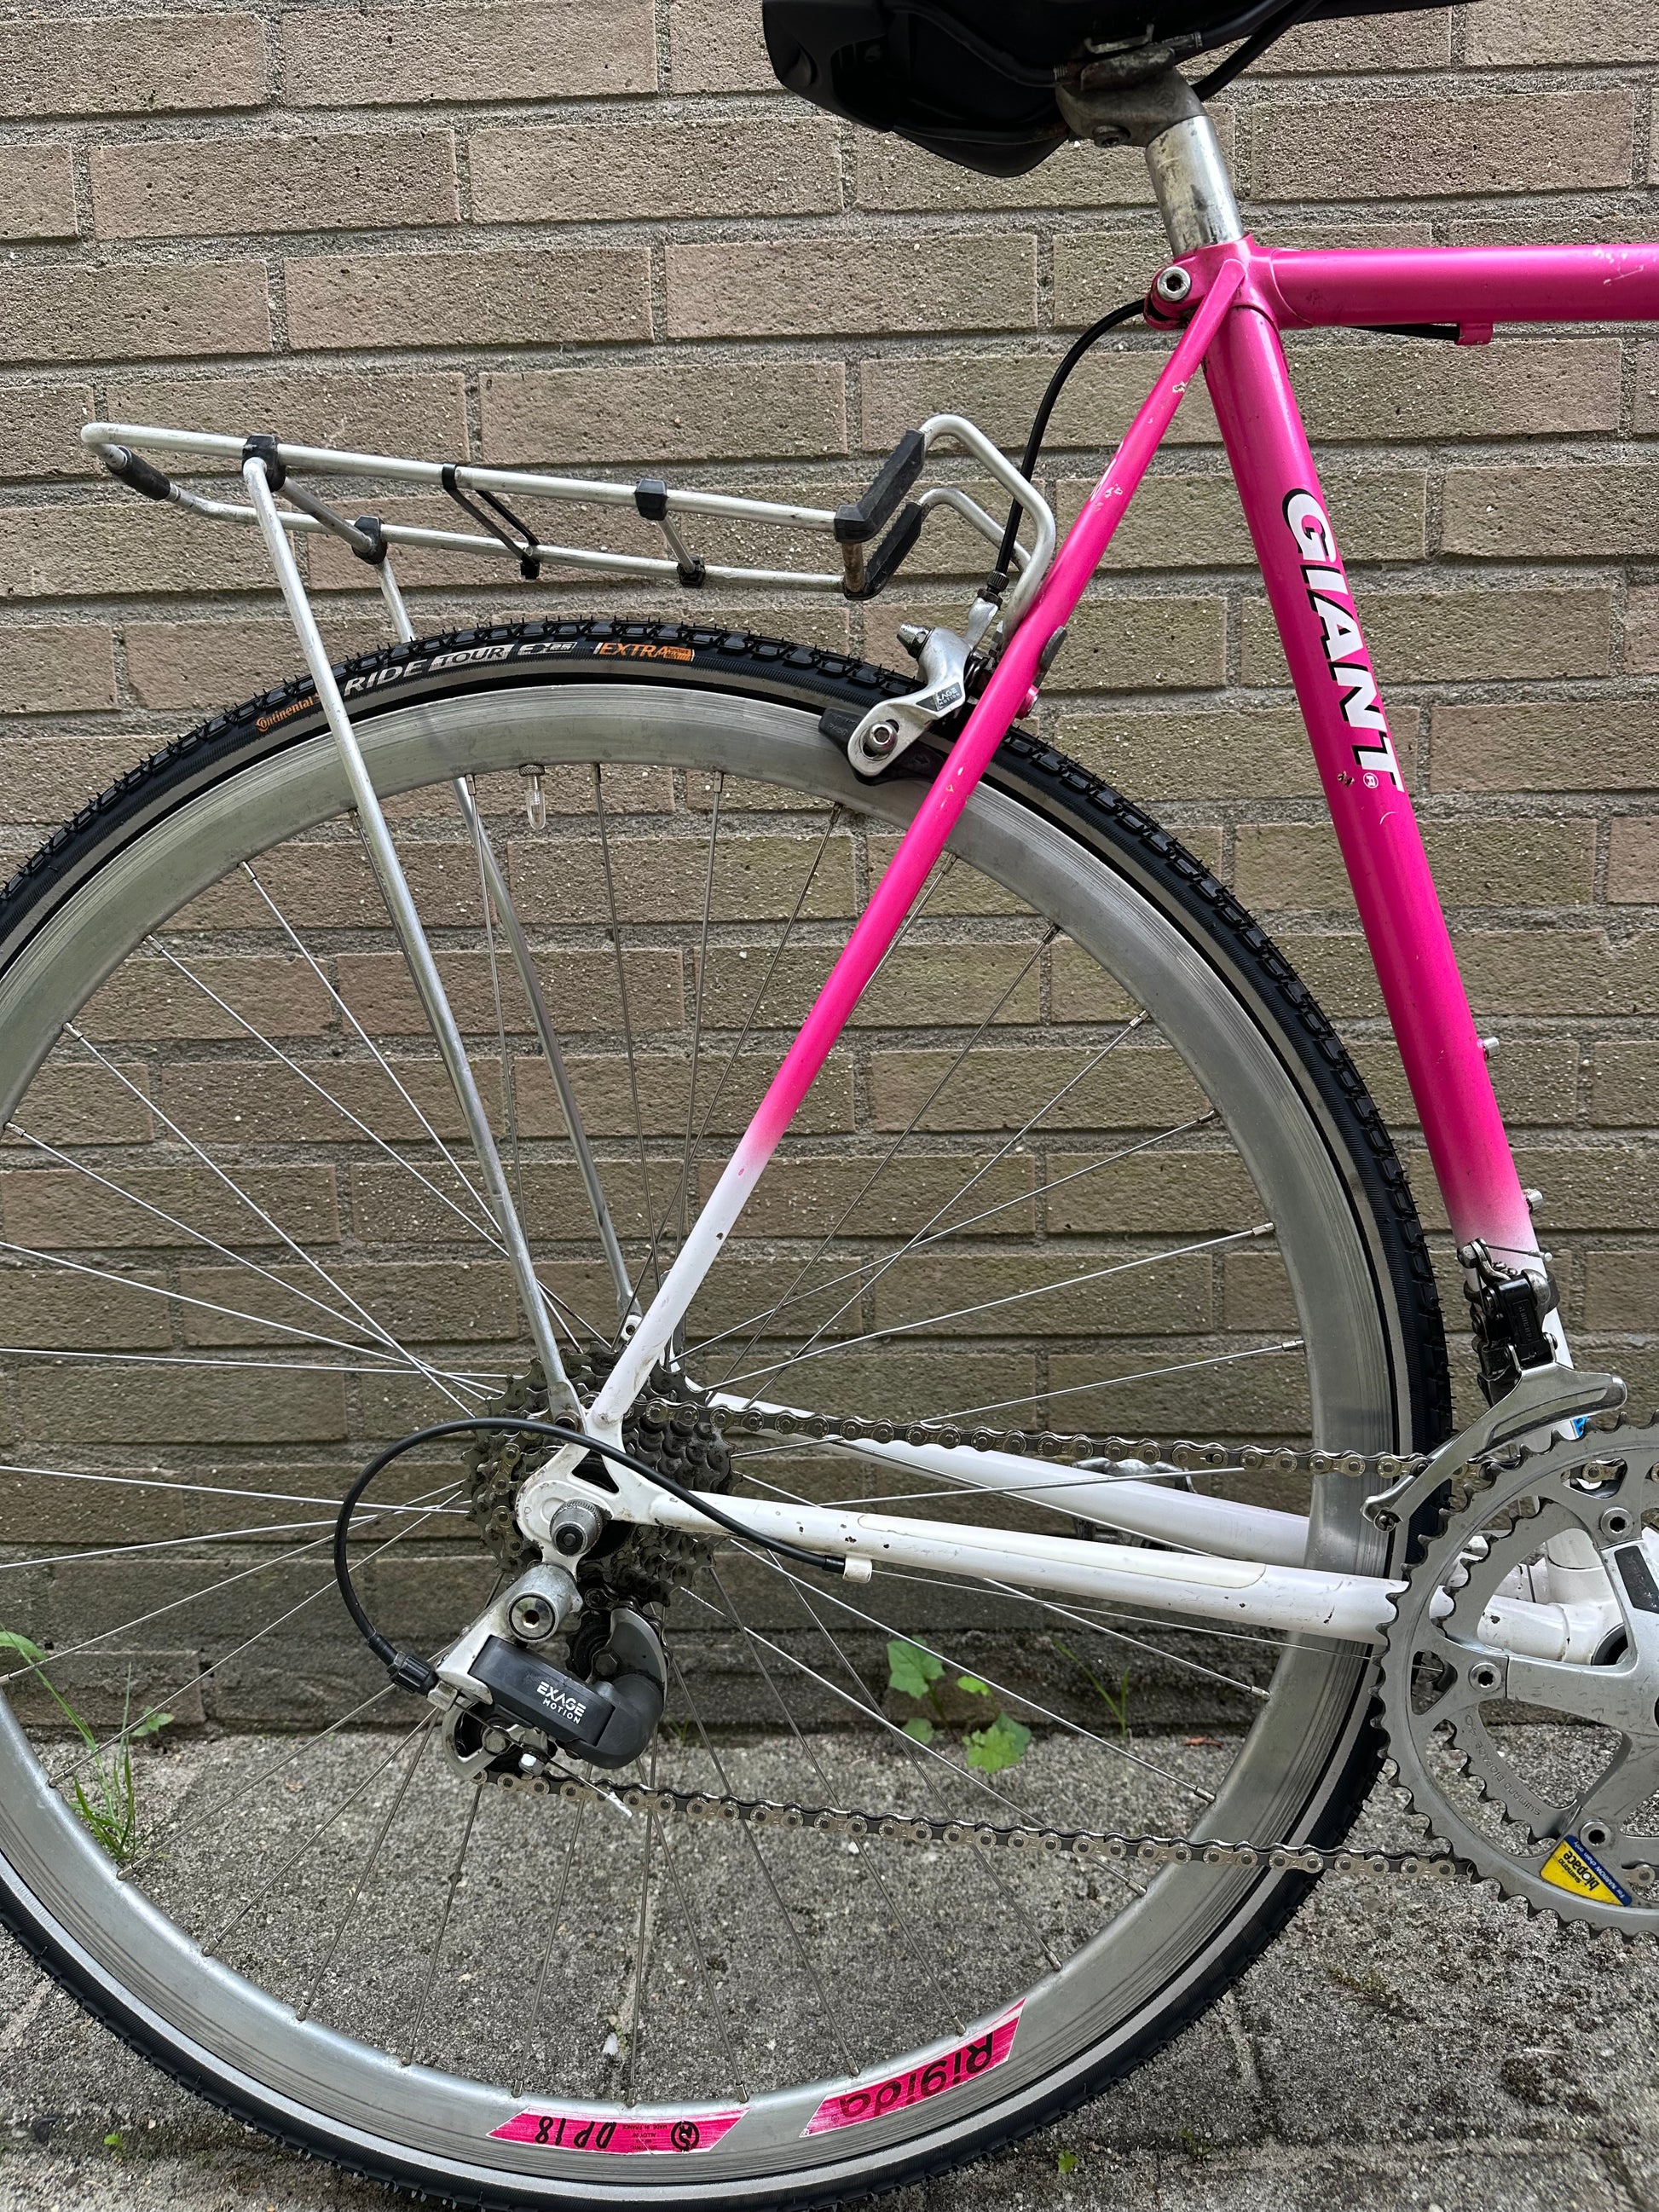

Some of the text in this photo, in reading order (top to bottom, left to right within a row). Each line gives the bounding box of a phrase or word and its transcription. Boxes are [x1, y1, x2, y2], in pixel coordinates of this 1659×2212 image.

[1282, 488, 1404, 792] GIANT
[343, 659, 427, 696] RIDE
[437, 647, 505, 667] TOUR
[600, 643, 669, 657] EXTRA
[255, 696, 315, 732] Continental
[537, 1681, 587, 1718] EXAGE
[542, 1698, 581, 1724] MOTION
[1476, 1741, 1505, 1782] BIOPACE
[1564, 1851, 1600, 1891] biopace
[1574, 1840, 1626, 1898] For NARROW chain only
[839, 2031, 993, 2117] Rigida
[535, 2116, 617, 2149] DP 18
